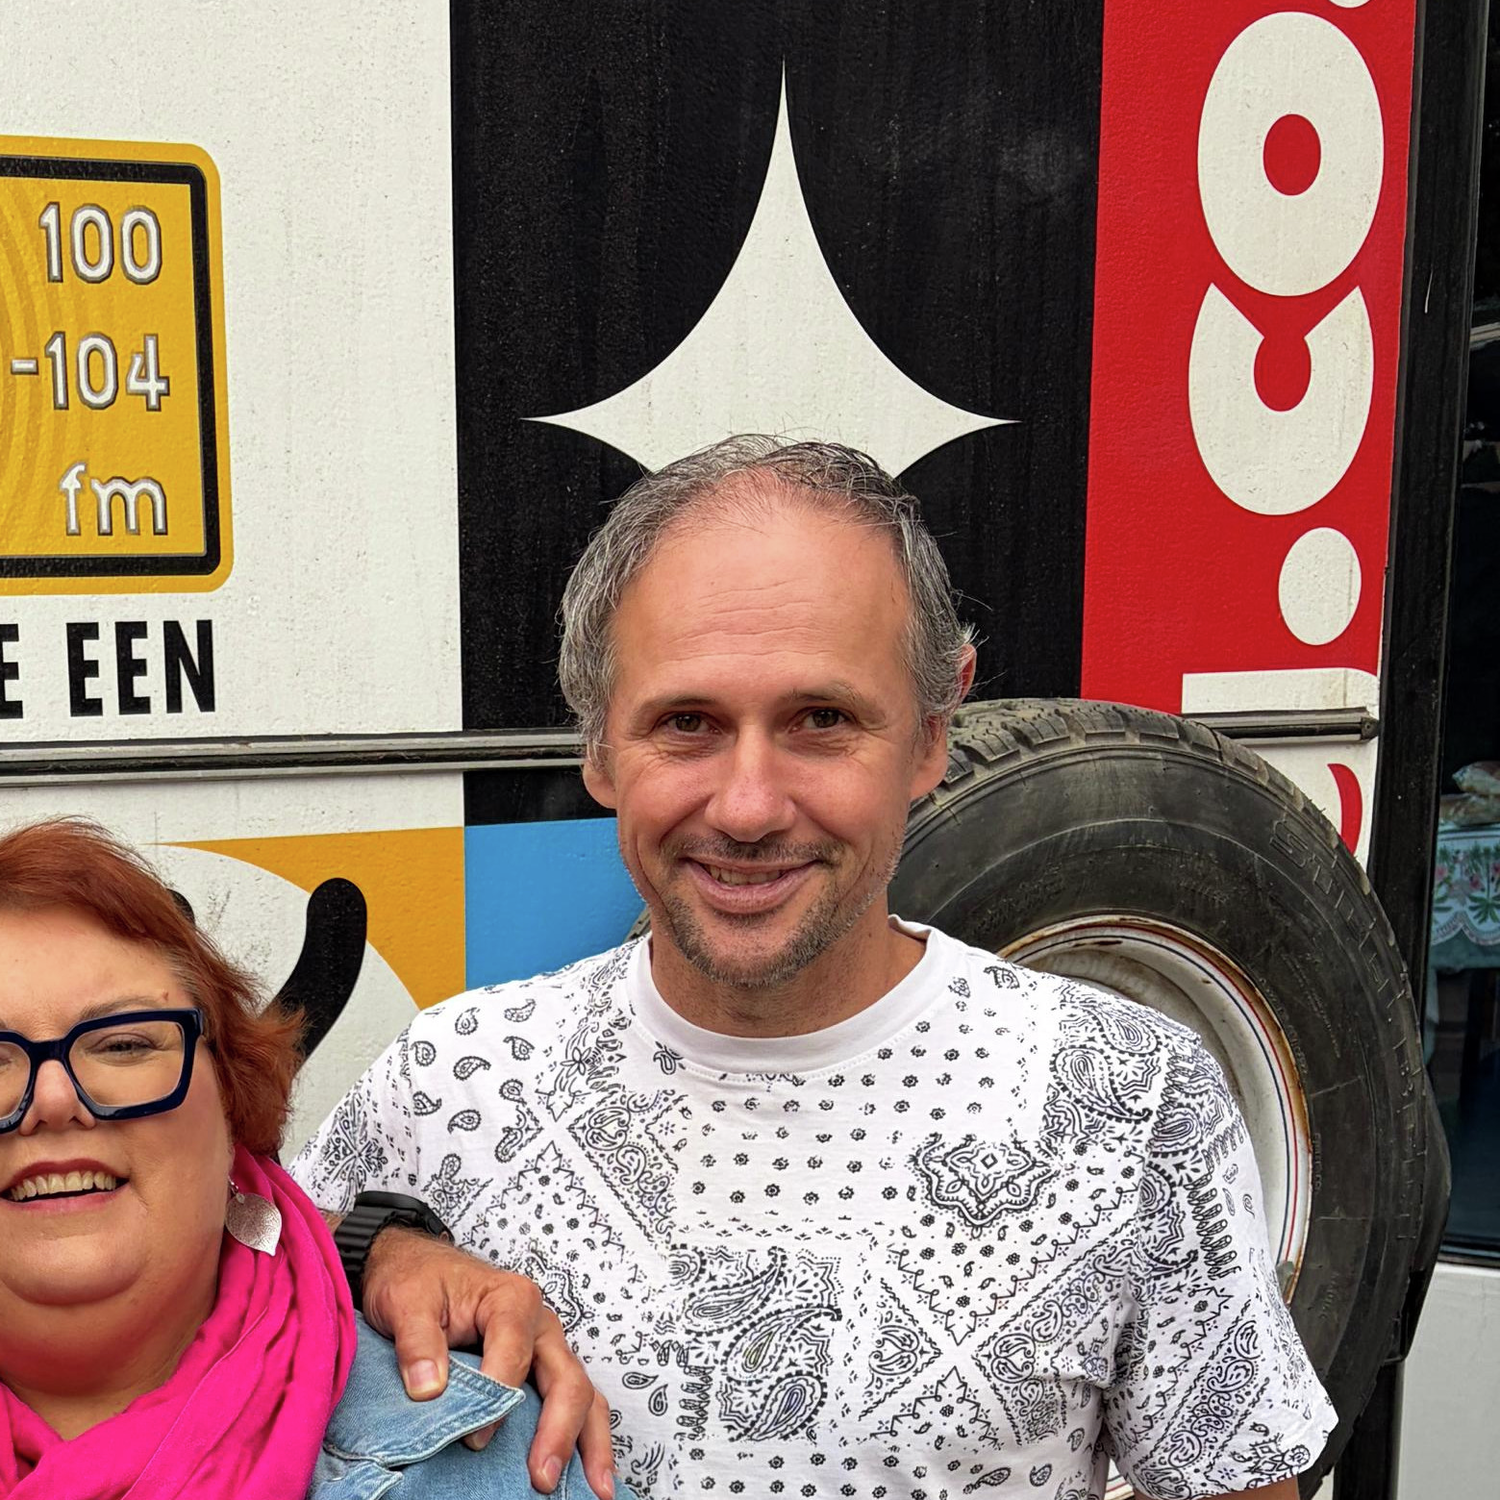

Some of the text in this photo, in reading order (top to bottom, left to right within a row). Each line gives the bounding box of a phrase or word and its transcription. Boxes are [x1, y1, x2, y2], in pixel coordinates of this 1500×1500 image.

[39, 201, 162, 285] 100
[11, 330, 171, 412] -104
[58, 461, 170, 537] fm
[66, 617, 217, 717] EEN
